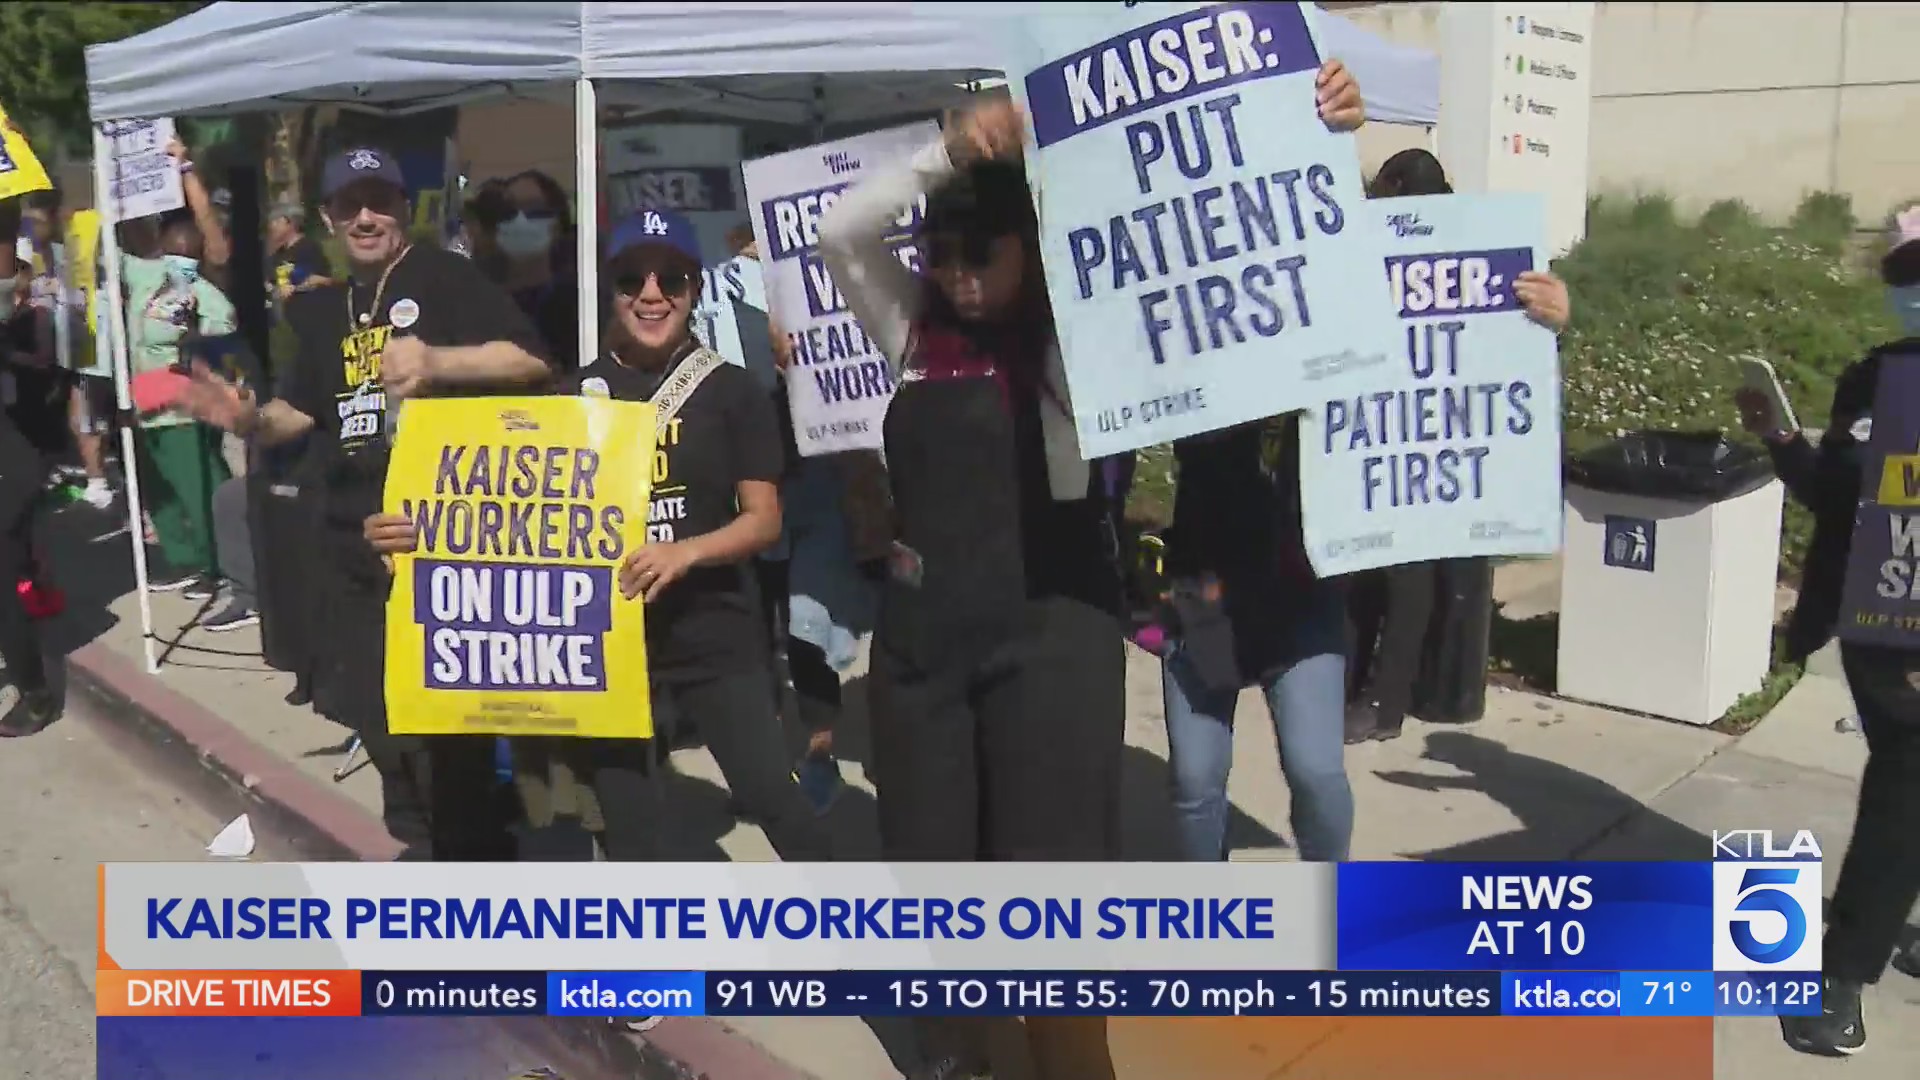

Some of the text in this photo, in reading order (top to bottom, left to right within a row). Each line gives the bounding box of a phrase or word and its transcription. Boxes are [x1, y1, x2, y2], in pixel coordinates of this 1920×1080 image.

[1063, 9, 1280, 126] KAISER:
[1124, 94, 1246, 194] PUT
[643, 211, 668, 235] LA
[1067, 164, 1345, 299] PATIENTS
[1138, 254, 1311, 364] FIRST
[1324, 380, 1534, 454] PATIENTS
[436, 445, 599, 498] KAISER
[1363, 446, 1490, 512] FIRST
[402, 499, 625, 559] WORKERS
[431, 565, 595, 627] ON ULP
[432, 627, 598, 686] STRIKE
